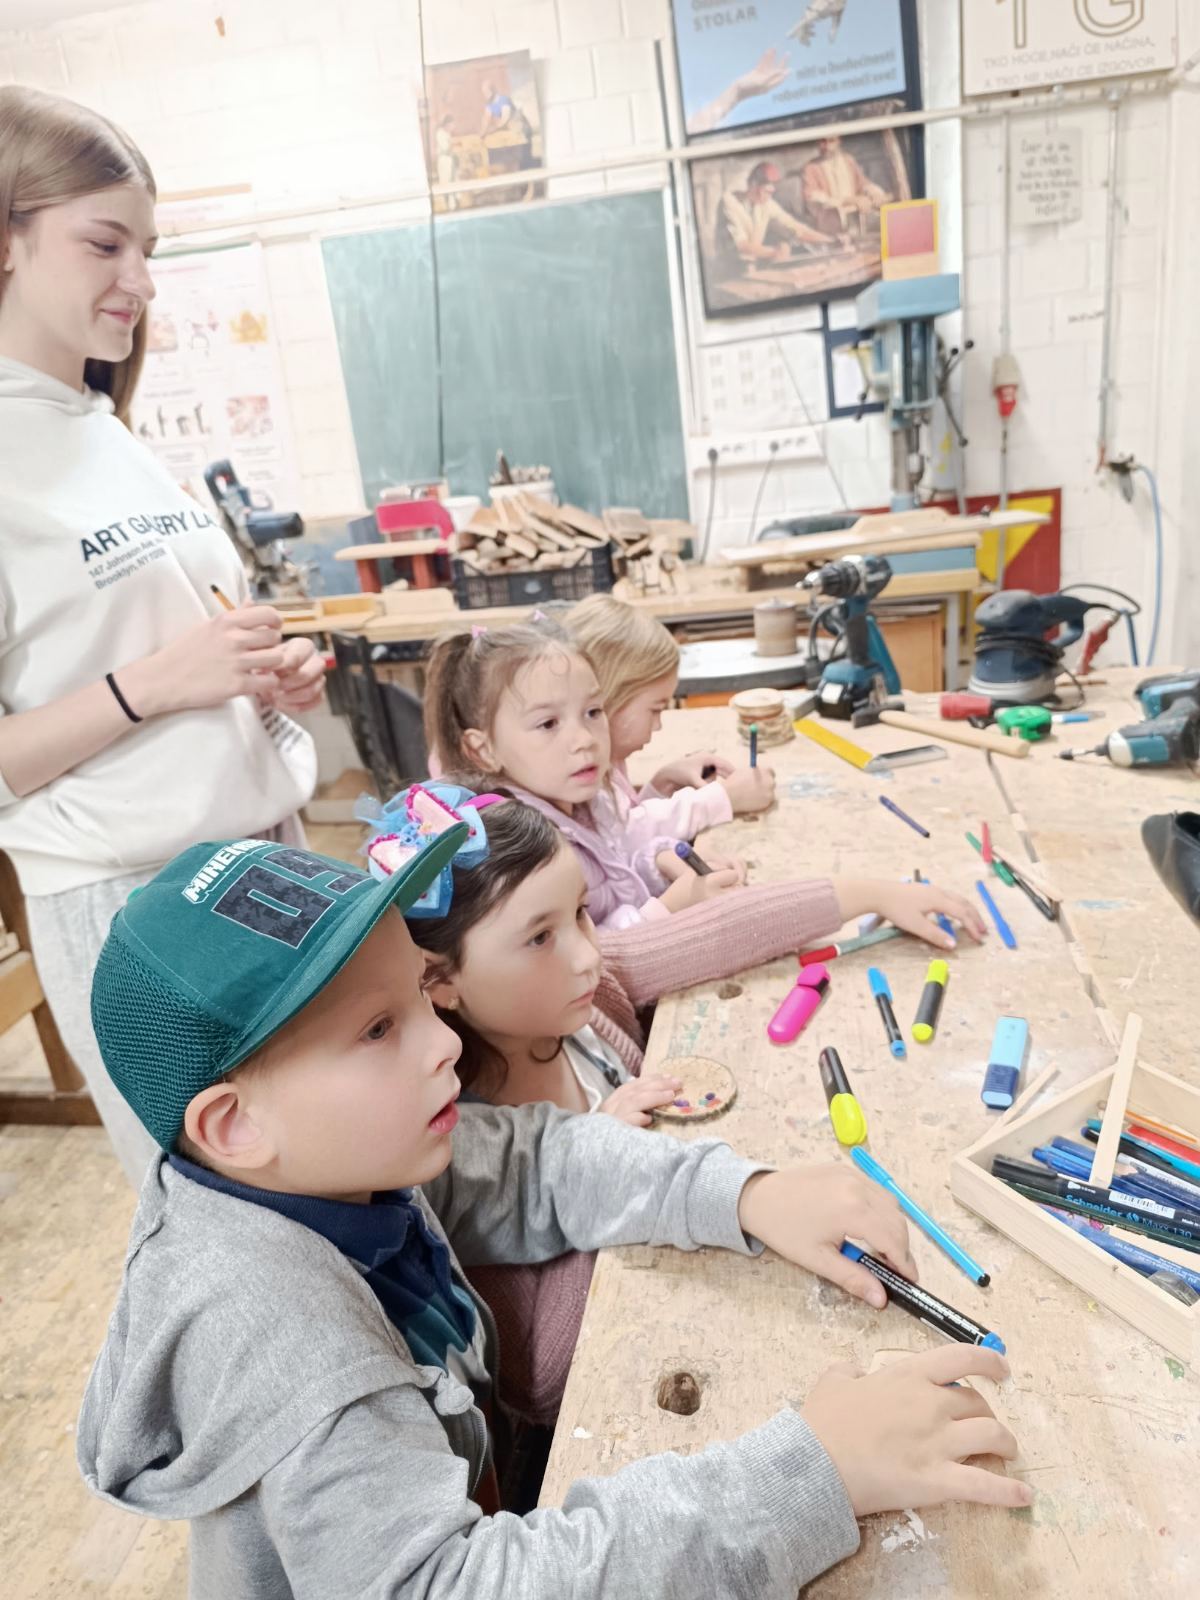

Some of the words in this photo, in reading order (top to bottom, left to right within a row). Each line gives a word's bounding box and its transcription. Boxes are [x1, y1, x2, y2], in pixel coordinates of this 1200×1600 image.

[693, 6, 757, 32] STOLAR
[80, 522, 130, 562] ART
[128, 511, 188, 536] GAERY
[89, 565, 104, 578] 147
[1065, 1194, 1122, 1217] Schneider
